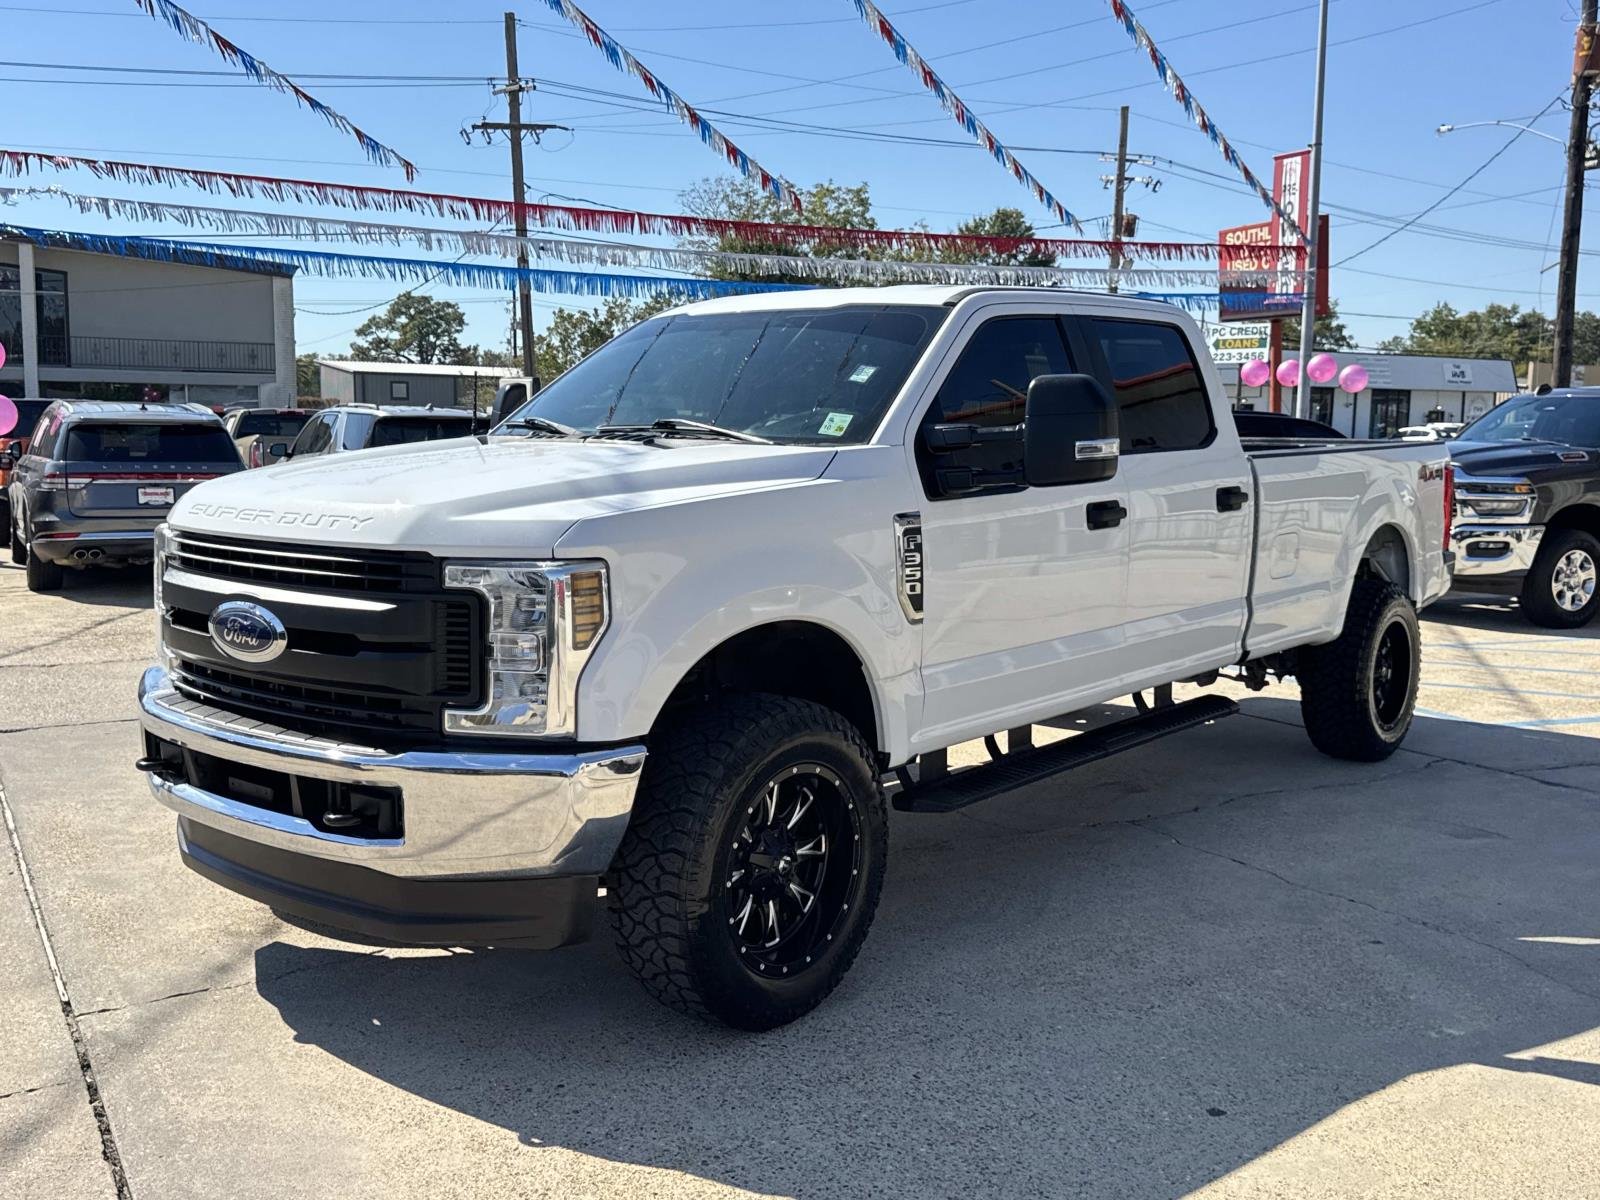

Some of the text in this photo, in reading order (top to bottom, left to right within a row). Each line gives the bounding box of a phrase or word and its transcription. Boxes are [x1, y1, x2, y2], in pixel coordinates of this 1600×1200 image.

[1229, 326, 1268, 336] CREDIT
[1219, 338, 1259, 349] LOANS
[1213, 352, 1265, 361] 223-3456
[188, 504, 374, 532] SUPER DUTY
[223, 616, 260, 647] Ford
